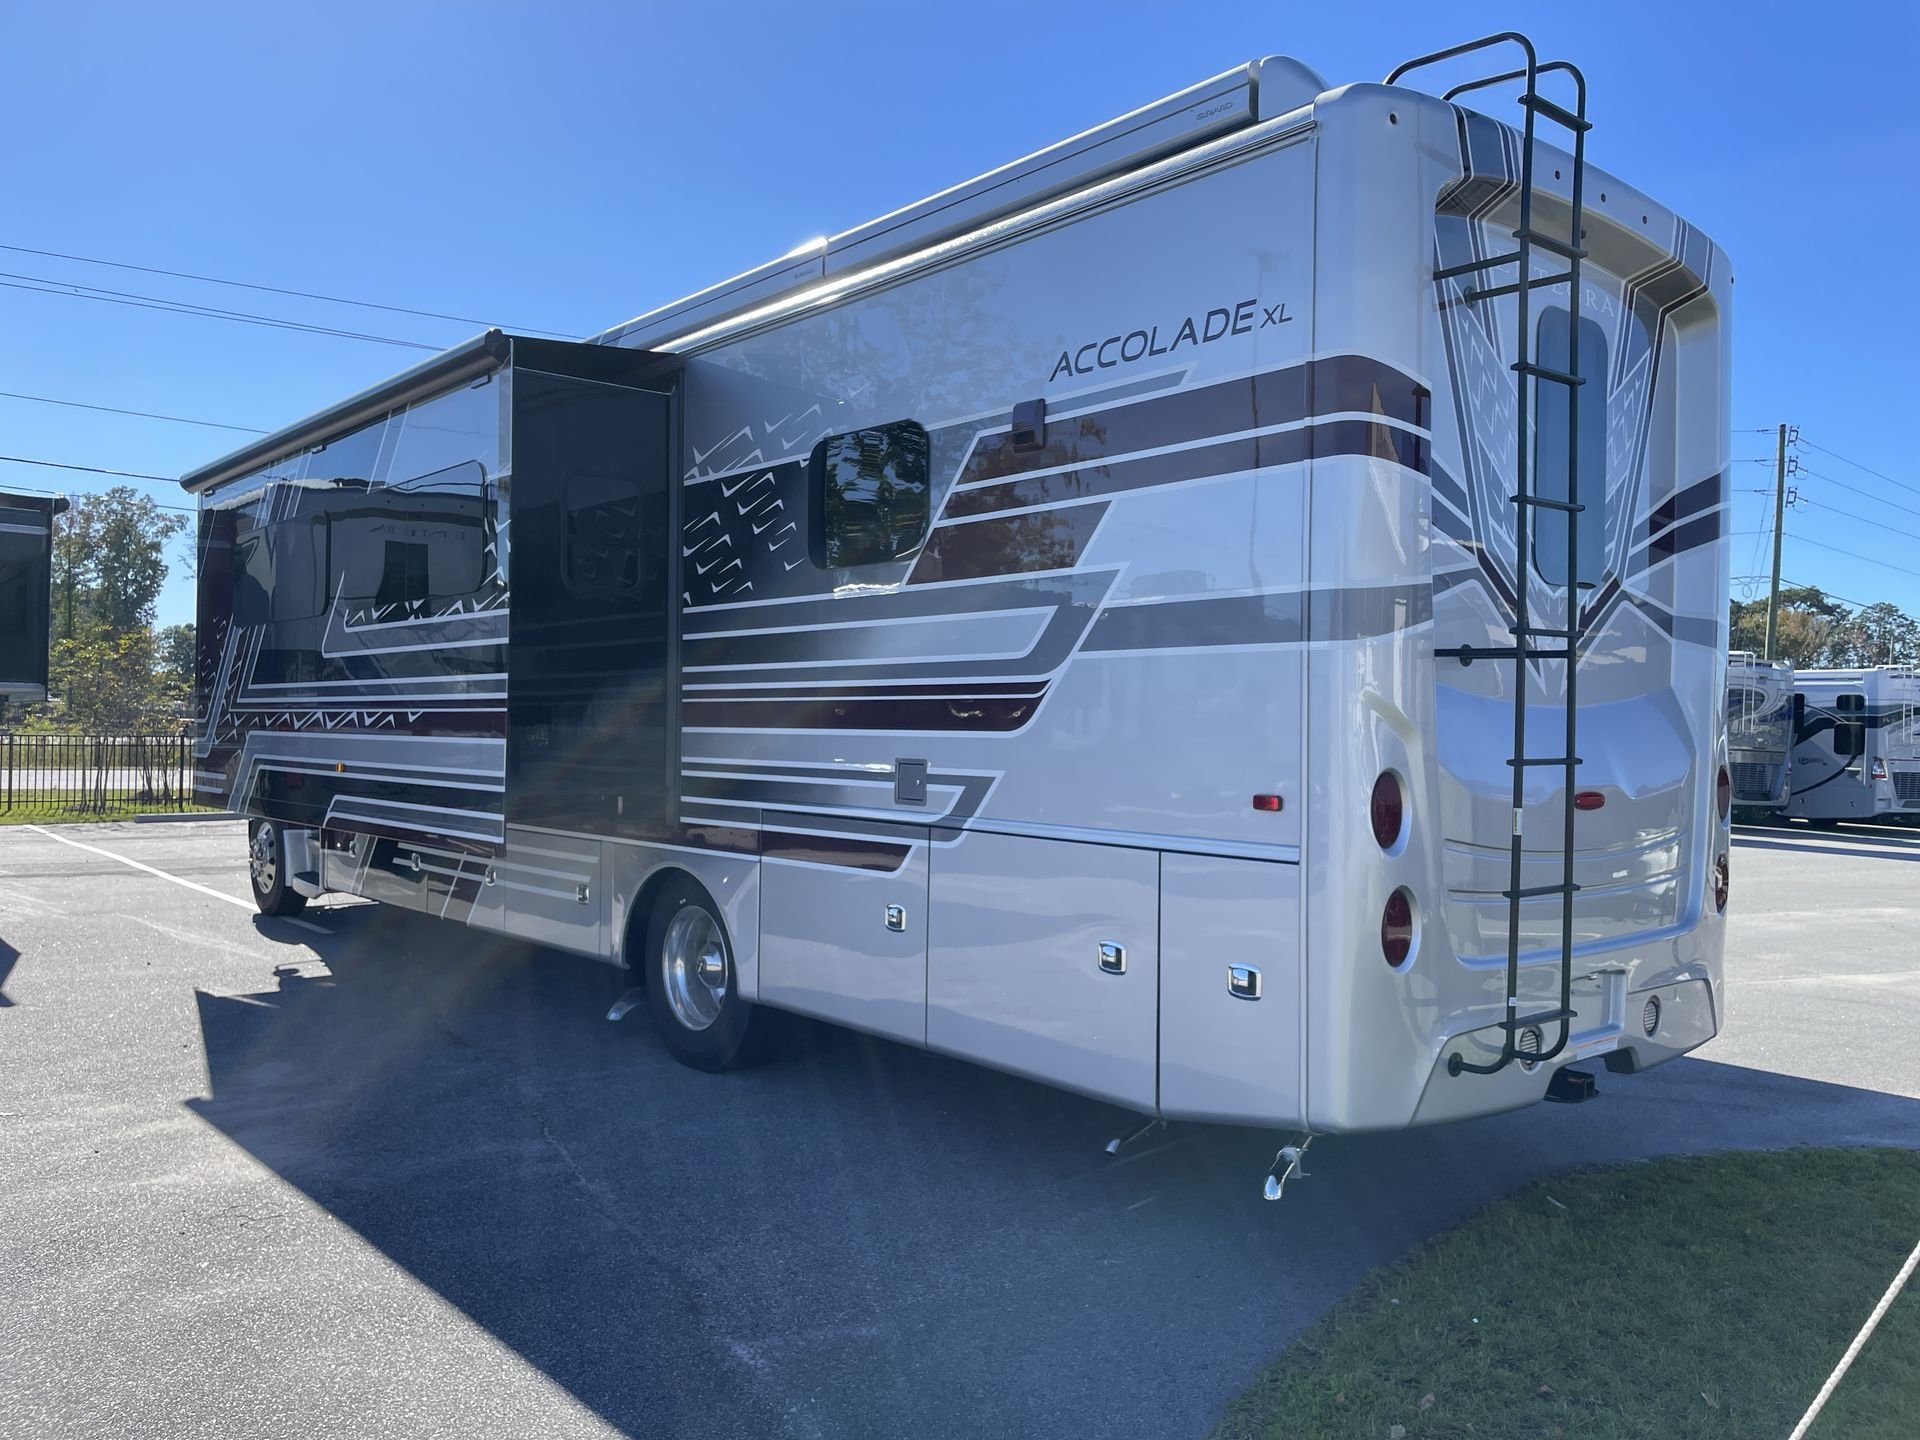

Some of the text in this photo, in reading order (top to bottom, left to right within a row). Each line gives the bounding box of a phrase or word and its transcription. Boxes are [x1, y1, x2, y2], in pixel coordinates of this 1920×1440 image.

[1495, 248, 1615, 317] ETERA
[1048, 298, 1293, 382] ACCOLADE XL
